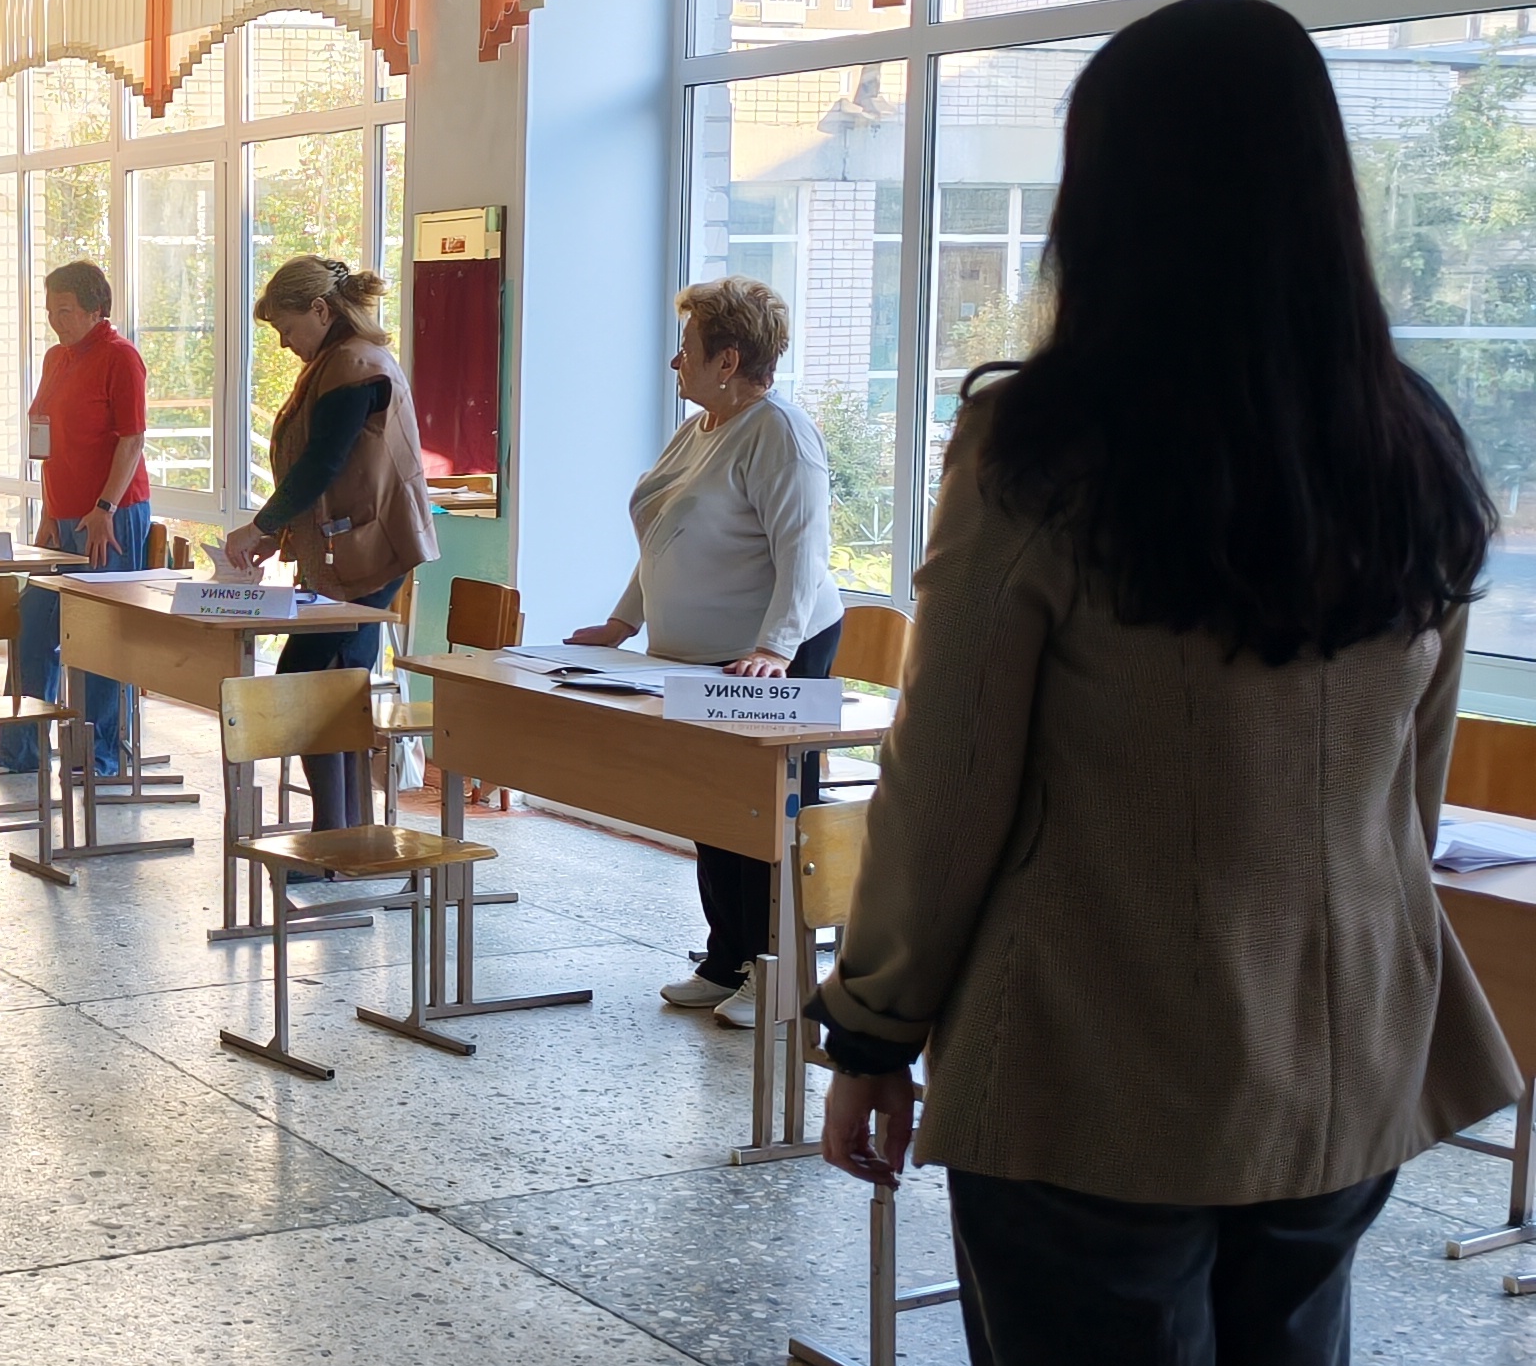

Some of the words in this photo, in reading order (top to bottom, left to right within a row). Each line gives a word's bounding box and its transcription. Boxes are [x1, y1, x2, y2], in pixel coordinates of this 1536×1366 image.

[200, 588, 241, 600] УИК№
[244, 590, 266, 601] 967
[704, 684, 763, 699] УИК№
[769, 686, 801, 700] 967
[707, 708, 728, 719] Ул.
[731, 709, 785, 720] Галкина
[789, 710, 797, 720] 4
